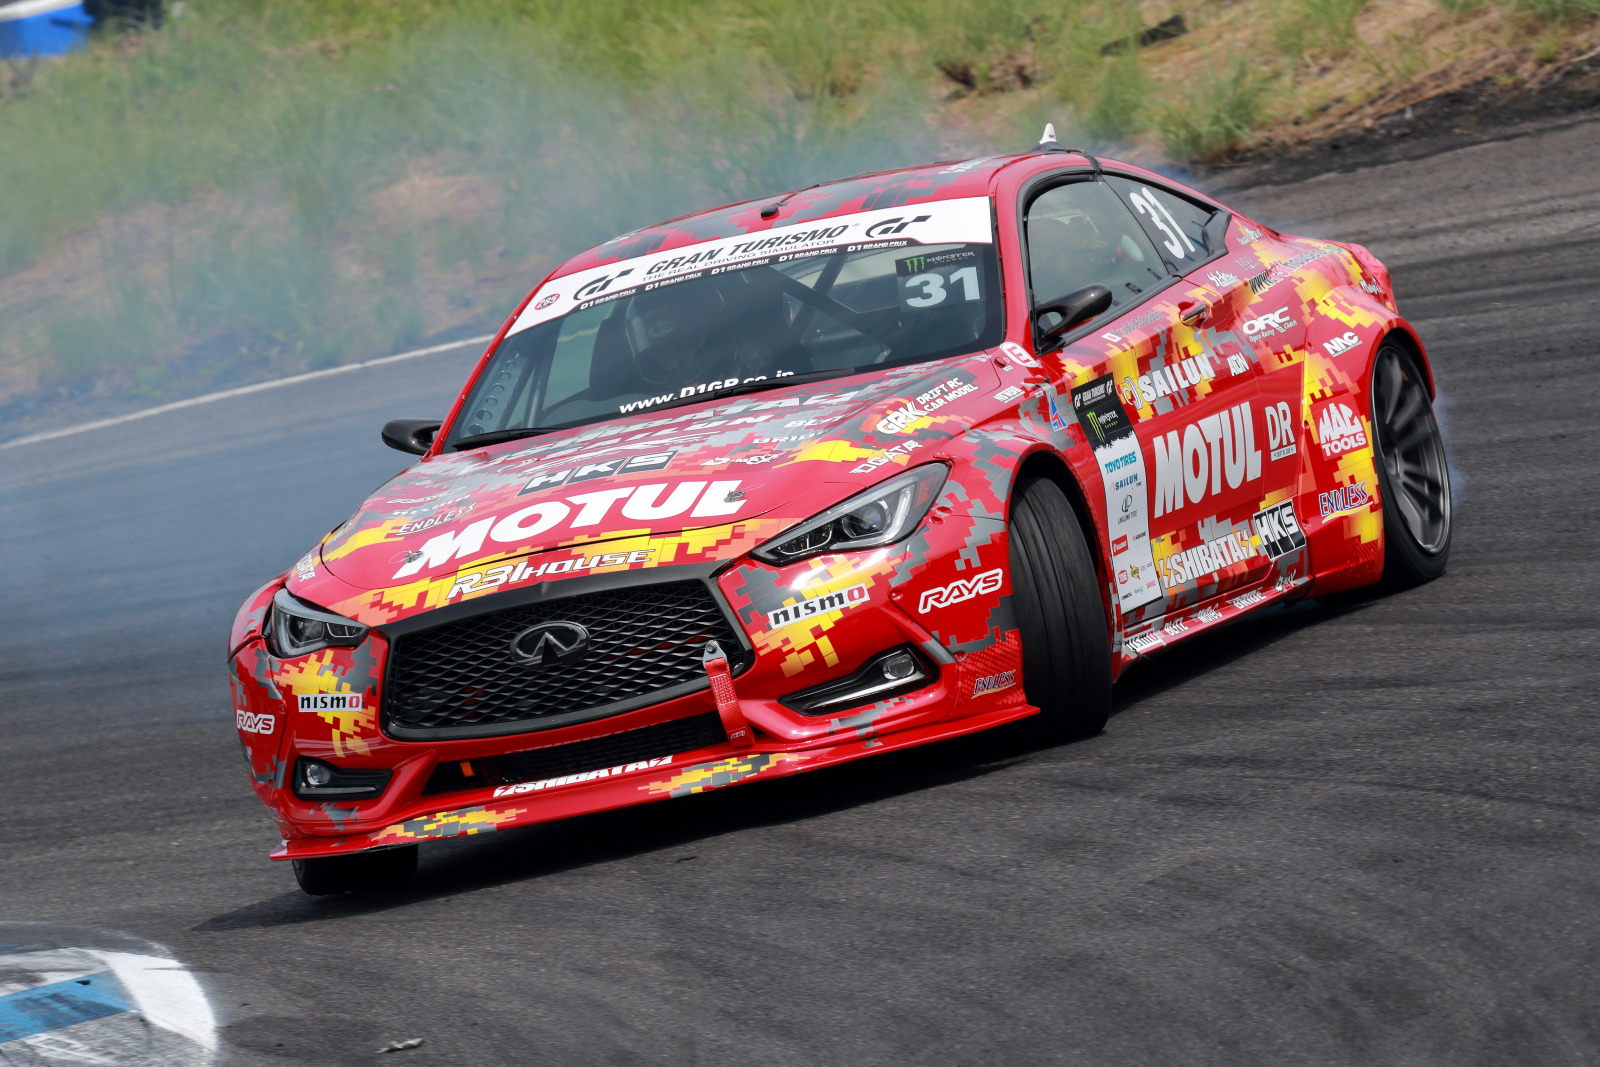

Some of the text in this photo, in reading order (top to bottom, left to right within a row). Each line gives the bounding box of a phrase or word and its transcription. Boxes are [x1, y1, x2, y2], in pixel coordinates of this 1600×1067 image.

[1129, 187, 1196, 259] 31
[642, 239, 835, 282] THE REAL DRIVING SIMULATOR
[646, 225, 849, 275] GRAN TURISMO
[779, 247, 838, 262] D1 GRAND PRIX
[847, 239, 907, 252] D1 GRAND PRIX
[927, 251, 975, 263] MONSTER
[644, 271, 702, 291] D1 GRAND PRIX
[711, 258, 769, 275] D1 GRAND PRIX
[580, 300, 596, 310] D1
[619, 288, 637, 298] PRIX
[905, 266, 980, 308] 31
[1242, 306, 1290, 335] ORC
[1322, 331, 1360, 355] NAC
[916, 377, 963, 405] DRIFT RC
[1137, 353, 1216, 403] SAILUN
[923, 398, 948, 411] CAR
[944, 383, 979, 402] MODEL
[875, 401, 930, 434] GRK
[1319, 402, 1363, 443] MAC
[541, 414, 775, 461] SAILUN
[1322, 432, 1367, 457] TOOLS
[524, 452, 672, 490] HKS
[1104, 451, 1137, 474] TOYO TIRES
[1152, 400, 1296, 519] MOTUL DR
[1115, 473, 1138, 491] SAILUN
[1319, 481, 1369, 516] ENDLESS
[391, 480, 748, 579] MOTUL
[397, 502, 477, 534] ENDLESS
[1255, 504, 1300, 546] HKS
[1170, 532, 1246, 584] SHIBATA
[773, 585, 865, 625] nismo
[918, 568, 1002, 614] RAYS
[972, 669, 1016, 697] ENDLESS
[301, 696, 359, 709] nismo
[237, 710, 275, 734] RAYS
